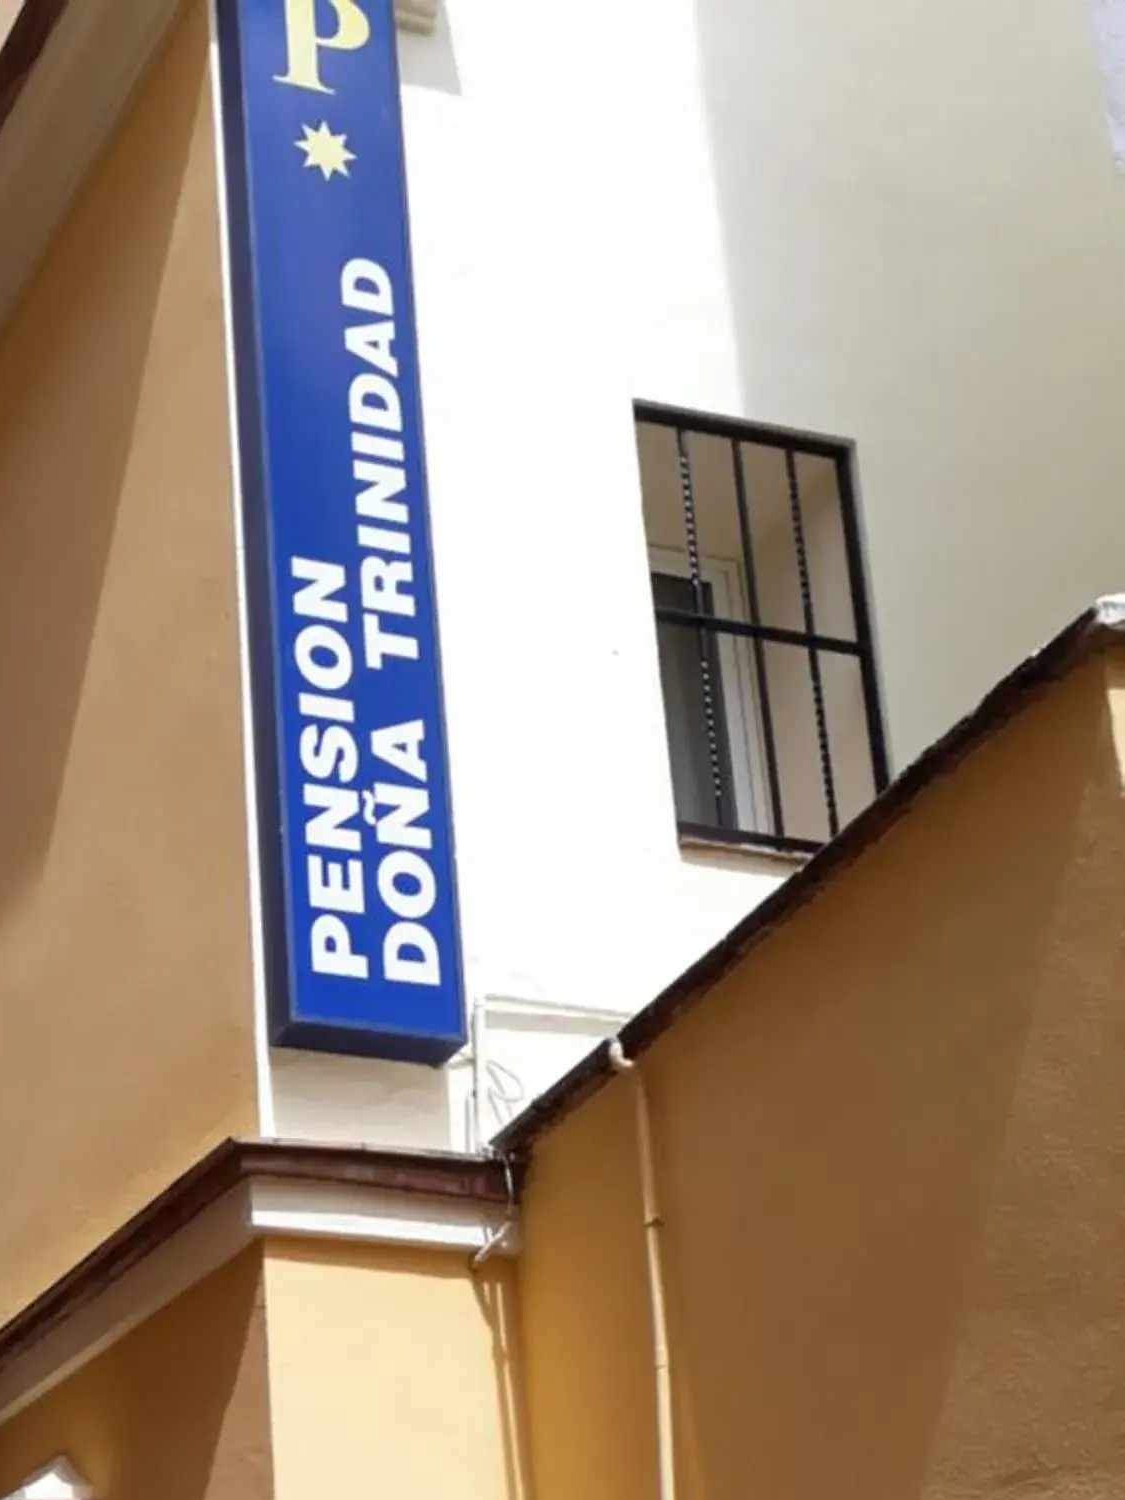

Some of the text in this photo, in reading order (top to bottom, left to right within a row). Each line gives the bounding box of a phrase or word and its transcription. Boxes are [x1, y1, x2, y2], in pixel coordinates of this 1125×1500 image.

[273, 0, 370, 95] P
[291, 556, 369, 981] PENSION
[341, 257, 441, 987] DOÑA TRINIDAD
